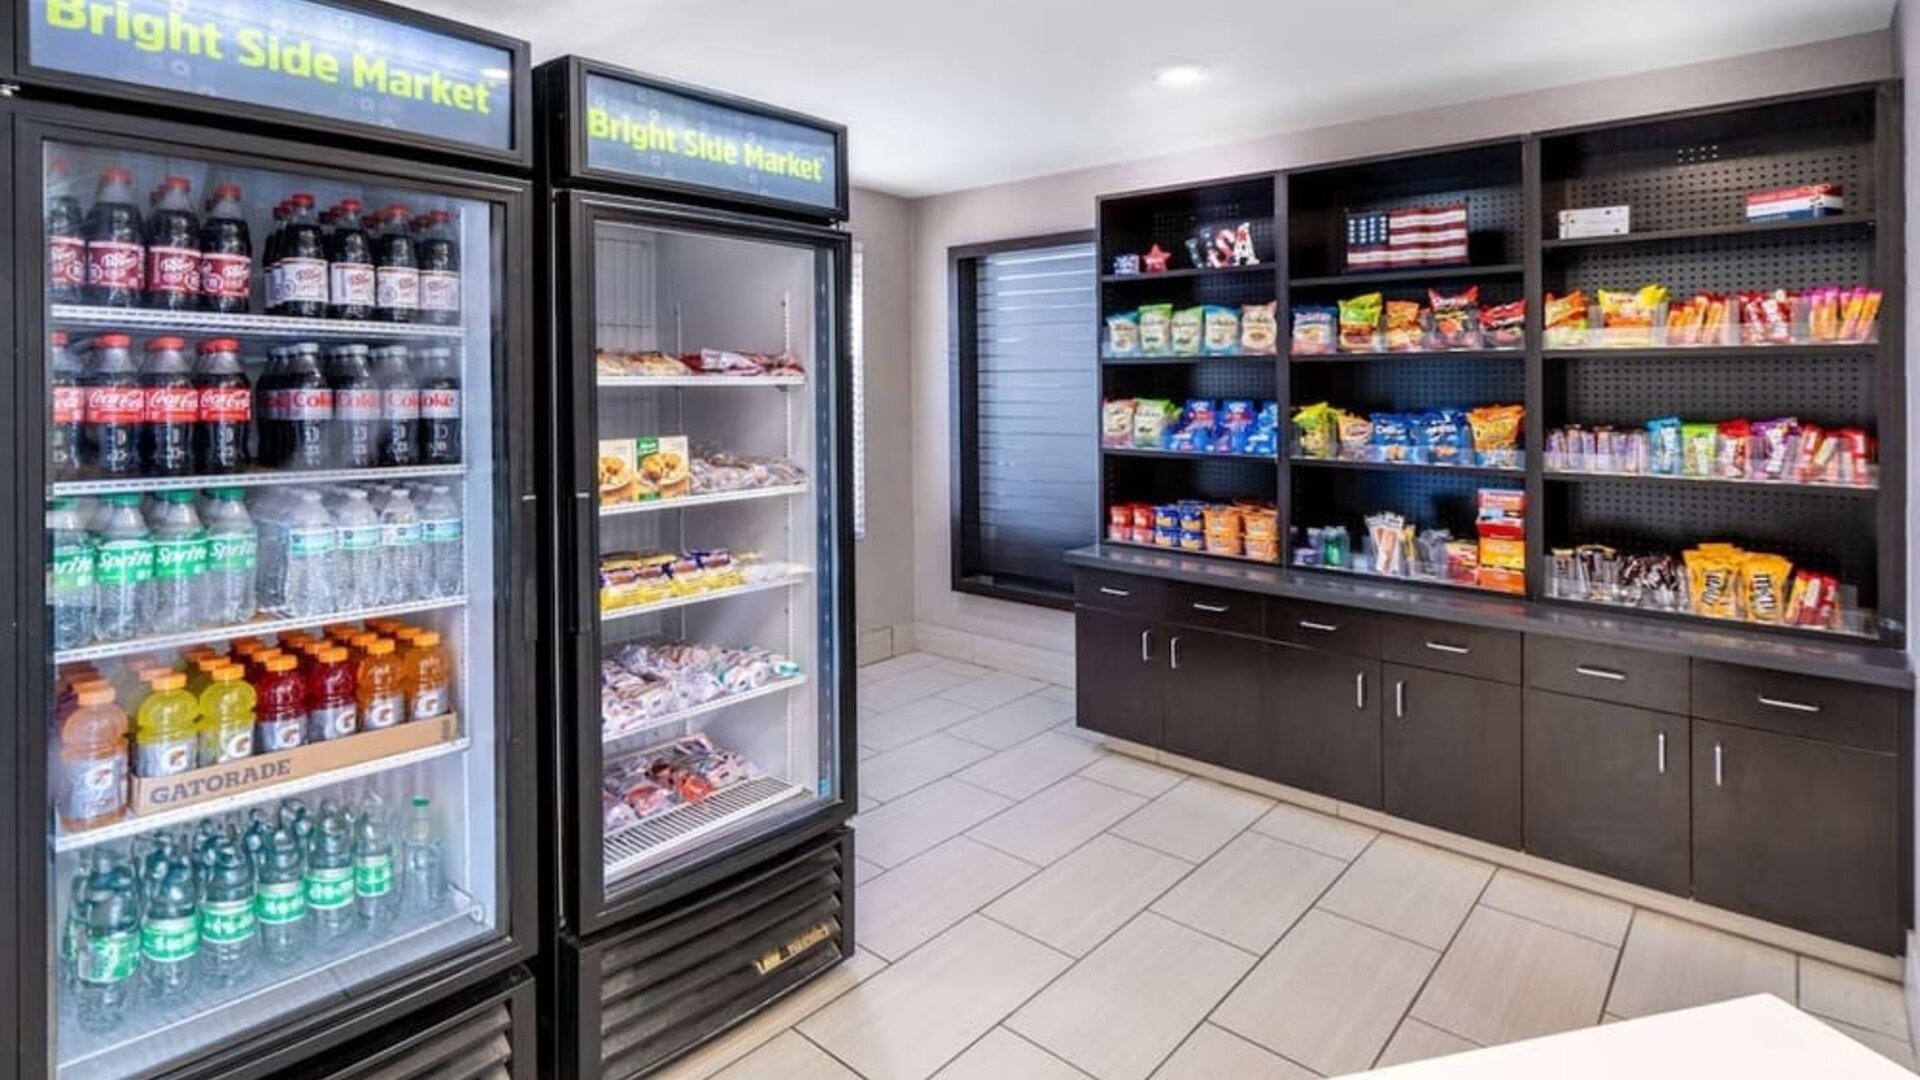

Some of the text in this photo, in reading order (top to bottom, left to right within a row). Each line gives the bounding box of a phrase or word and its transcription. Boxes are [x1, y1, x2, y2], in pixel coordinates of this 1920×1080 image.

[45, 0, 491, 115] Bright Side Market
[587, 106, 823, 182] Bright Side Market
[149, 759, 292, 804] GATORADE
